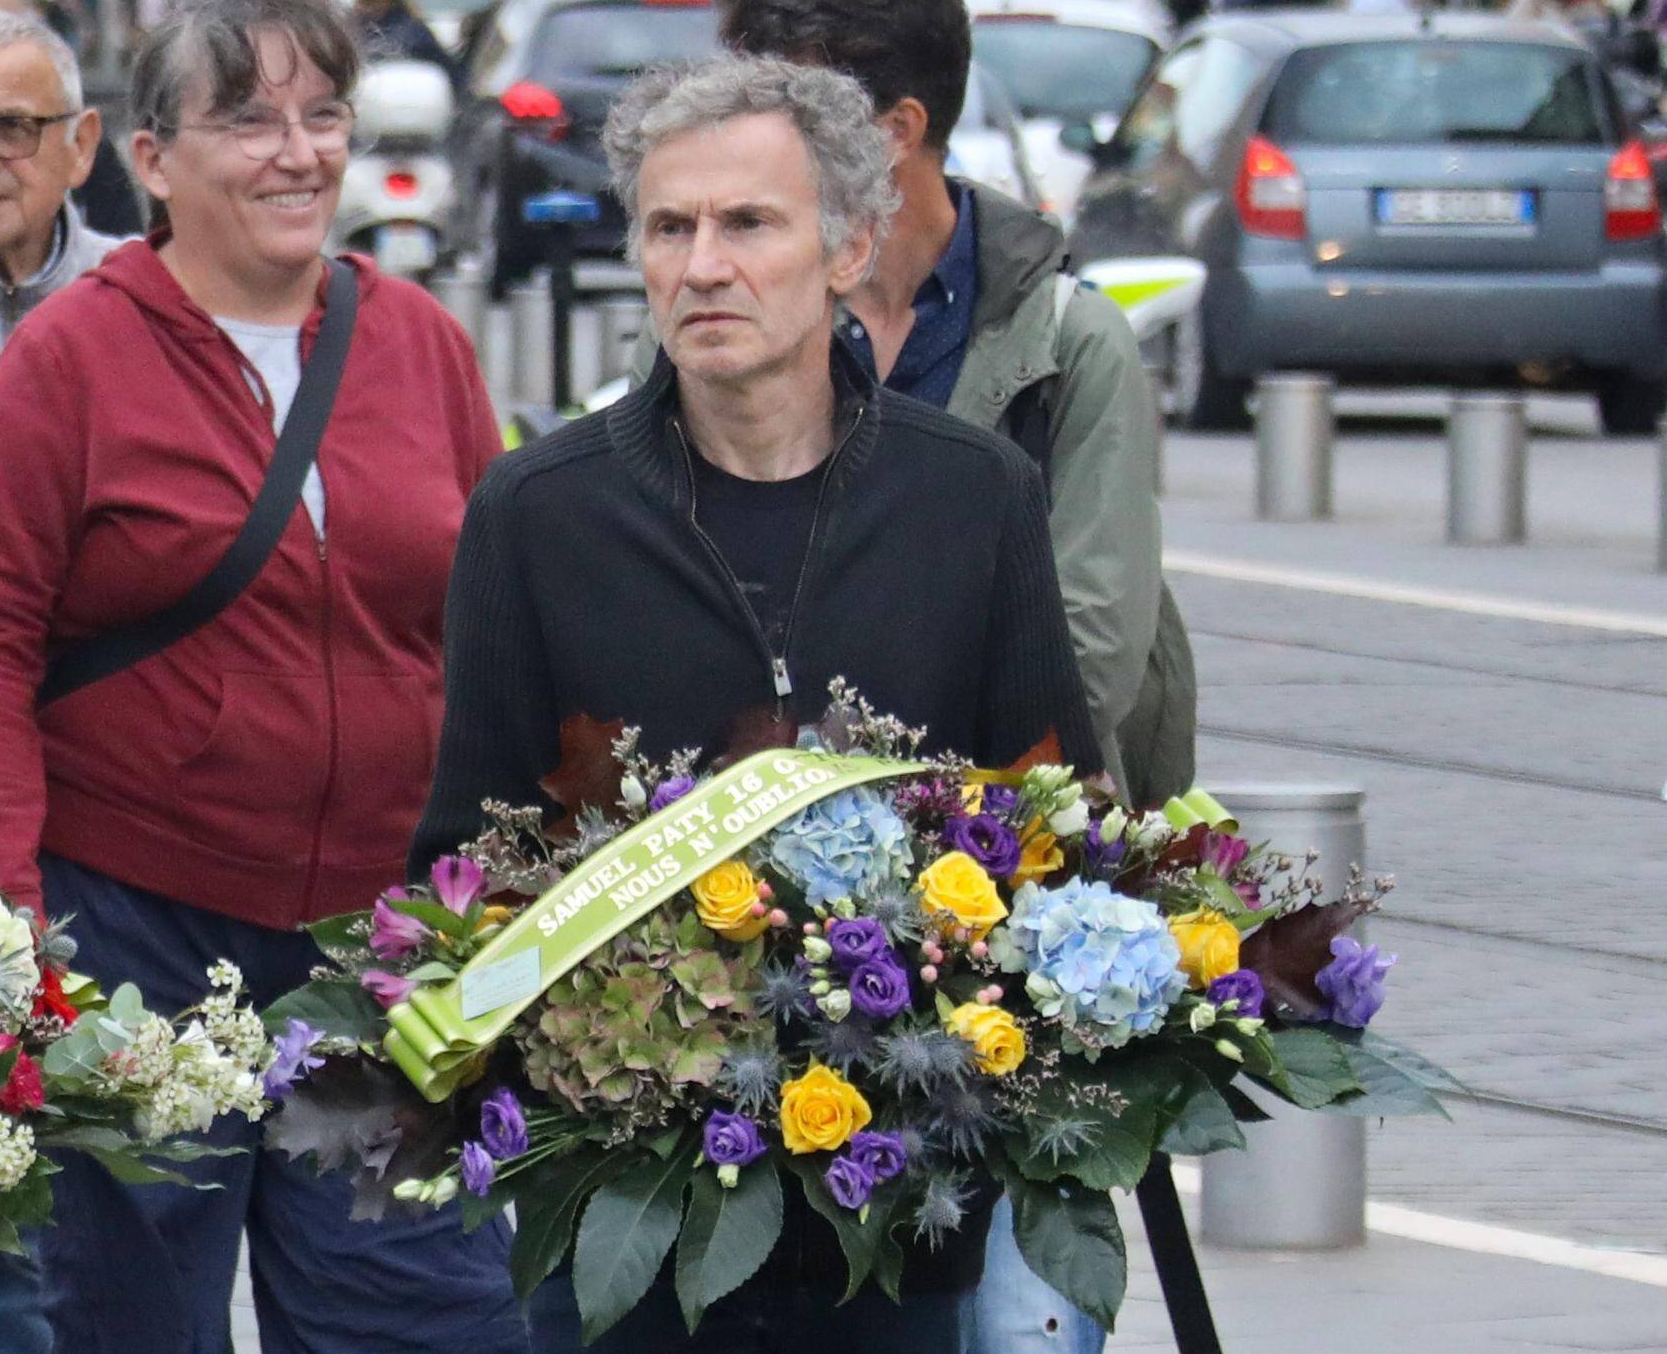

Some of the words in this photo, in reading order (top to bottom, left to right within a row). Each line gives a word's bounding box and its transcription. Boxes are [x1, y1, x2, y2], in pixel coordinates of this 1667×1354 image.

[537, 857, 636, 937] SAMUEL
[642, 802, 716, 857] PATY
[725, 772, 763, 803] 16
[608, 854, 682, 910] NOUS
[688, 768, 838, 858] N'OUBLIO
